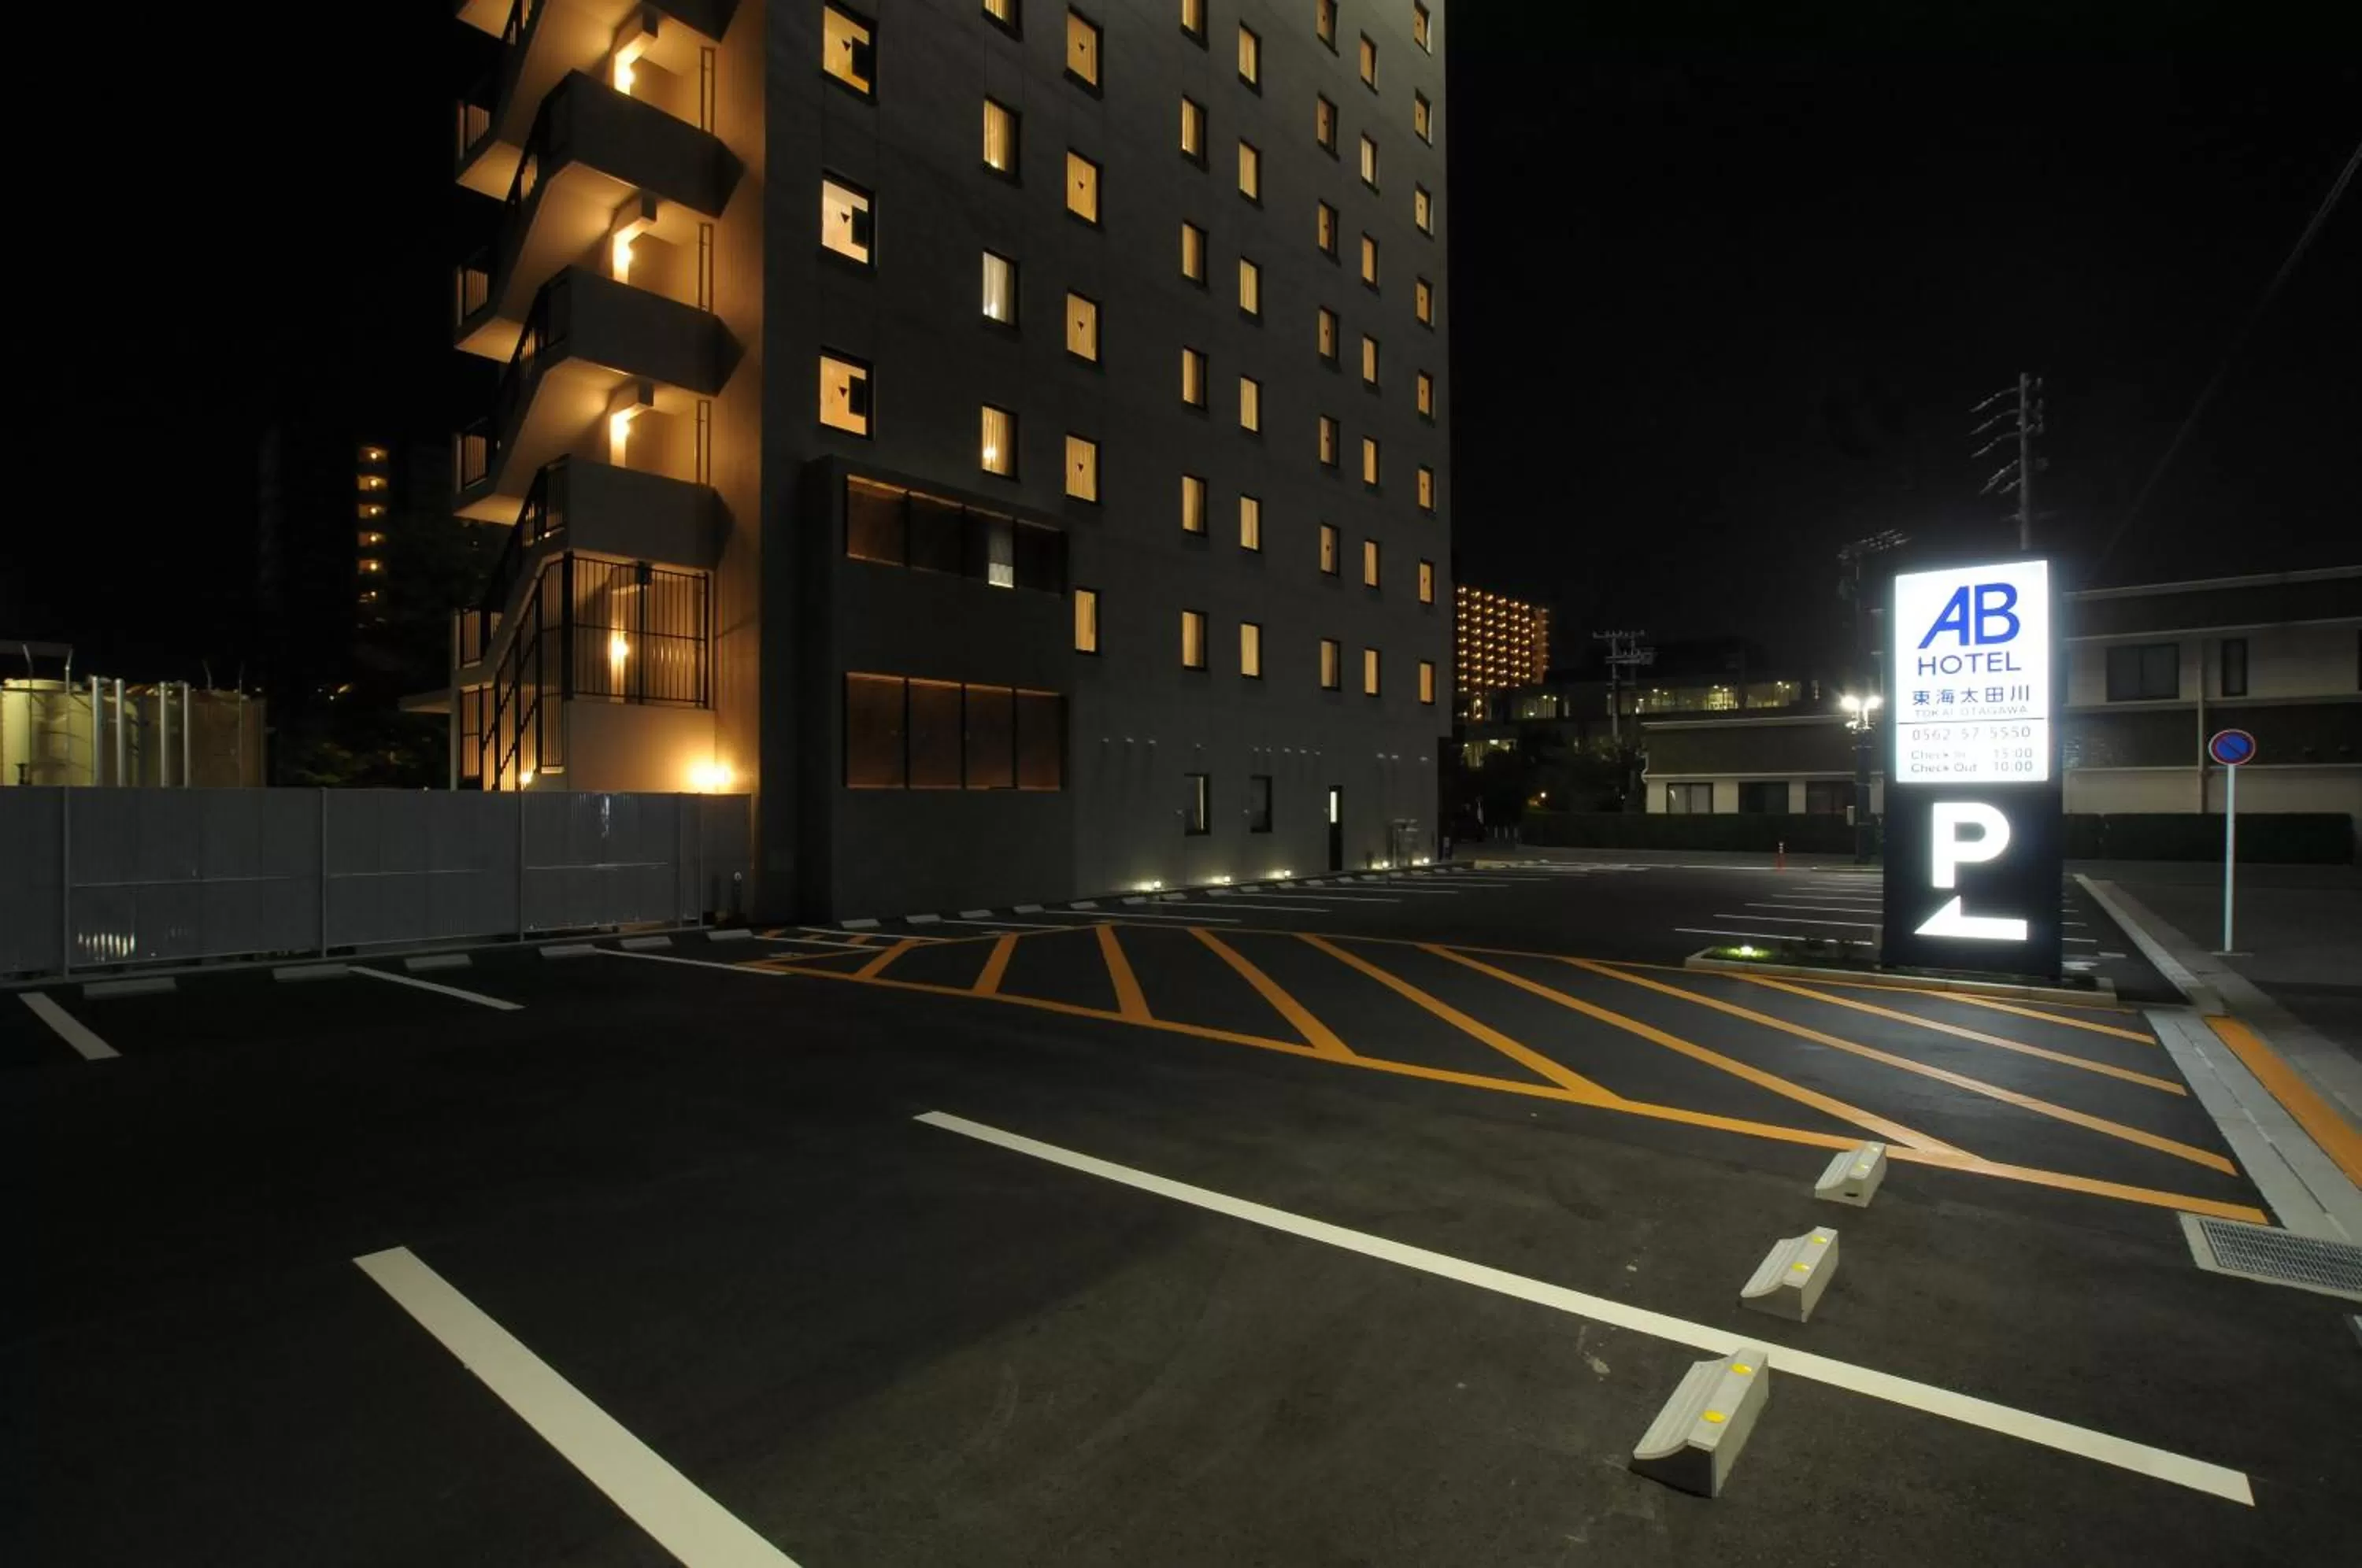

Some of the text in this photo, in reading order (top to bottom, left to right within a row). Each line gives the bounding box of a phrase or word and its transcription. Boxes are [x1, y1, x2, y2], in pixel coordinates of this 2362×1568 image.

[1917, 582, 2021, 649] AB
[1918, 651, 2022, 676] HOTEL
[1912, 684, 2031, 706] 東海太田川
[1912, 727, 1951, 741] 0562
[1953, 762, 1978, 772] Out
[1933, 802, 2010, 888] P
